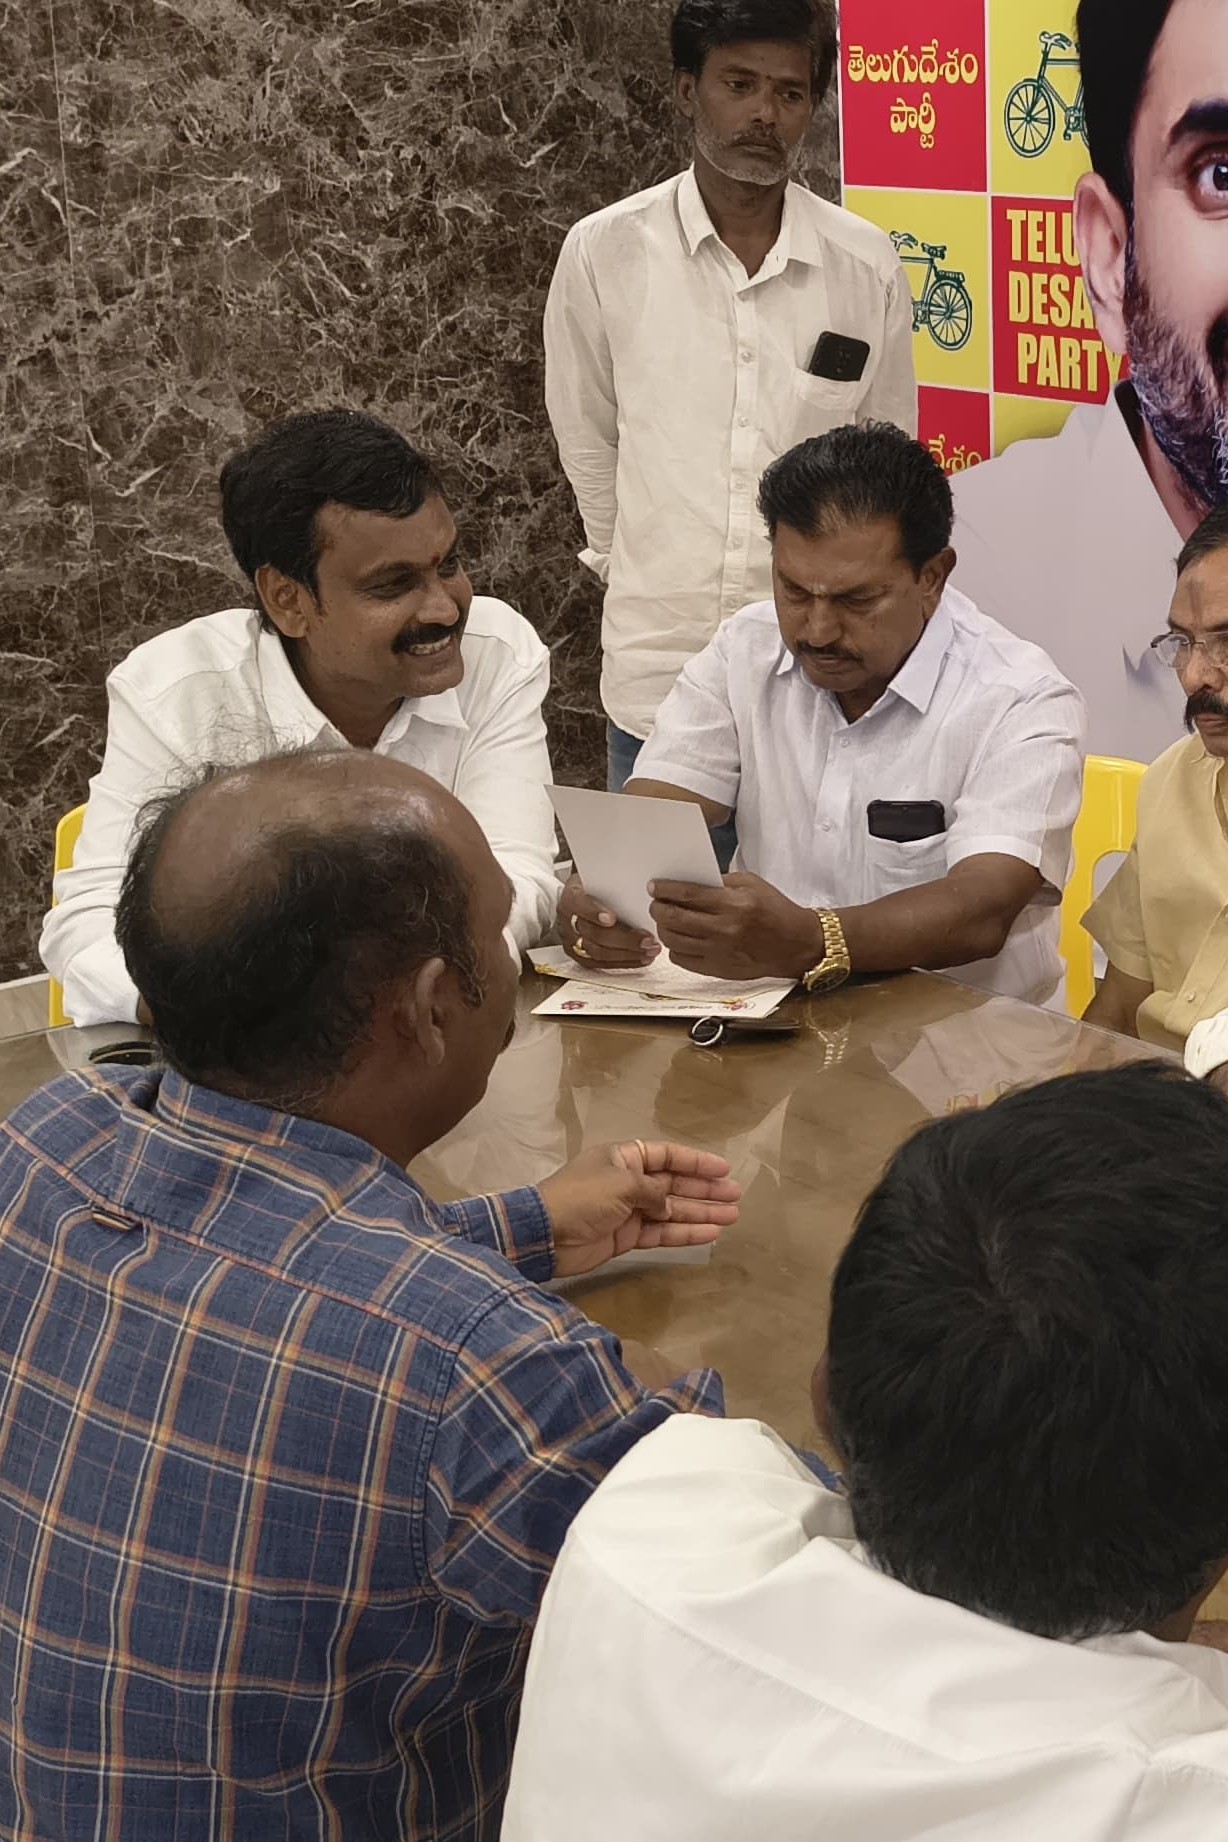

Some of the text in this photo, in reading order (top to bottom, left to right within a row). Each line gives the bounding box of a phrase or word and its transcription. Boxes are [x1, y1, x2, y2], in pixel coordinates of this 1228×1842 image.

[847, 38, 979, 85] తెలుగుదేశం
[890, 91, 938, 150] పార్టీ
[1008, 270, 1097, 330] DESA
